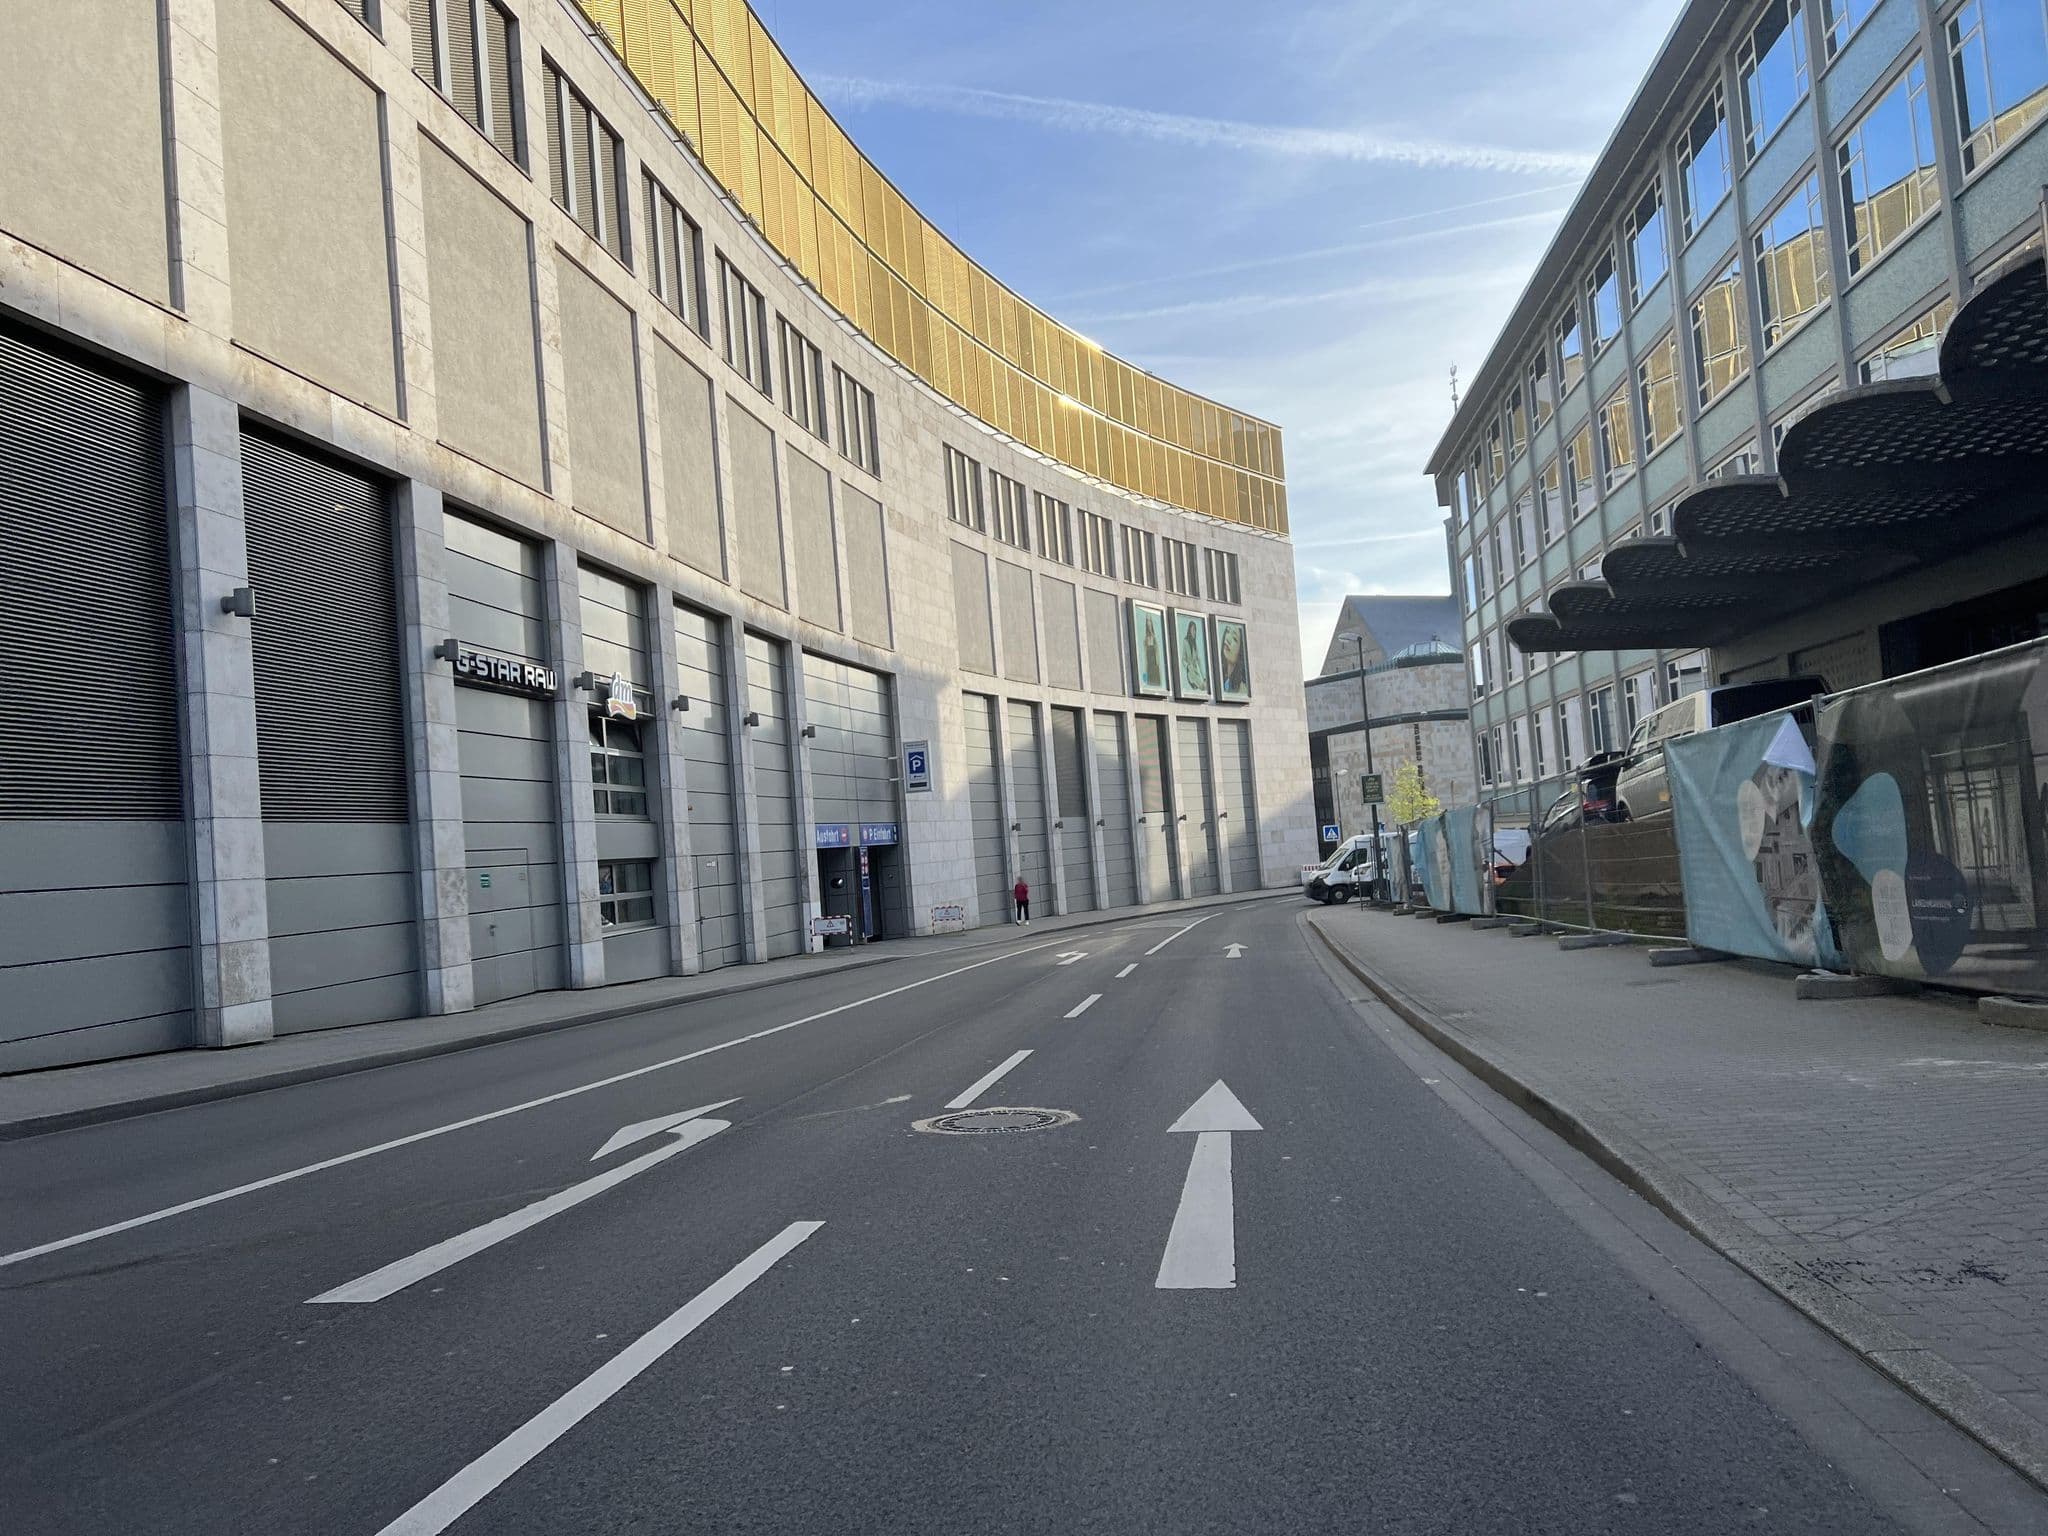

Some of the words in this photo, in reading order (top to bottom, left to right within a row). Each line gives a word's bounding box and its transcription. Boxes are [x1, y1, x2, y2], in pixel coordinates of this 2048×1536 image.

[456, 651, 521, 684] G-STAR
[524, 665, 558, 690] RAW
[613, 672, 633, 703] dm
[912, 759, 921, 771] P
